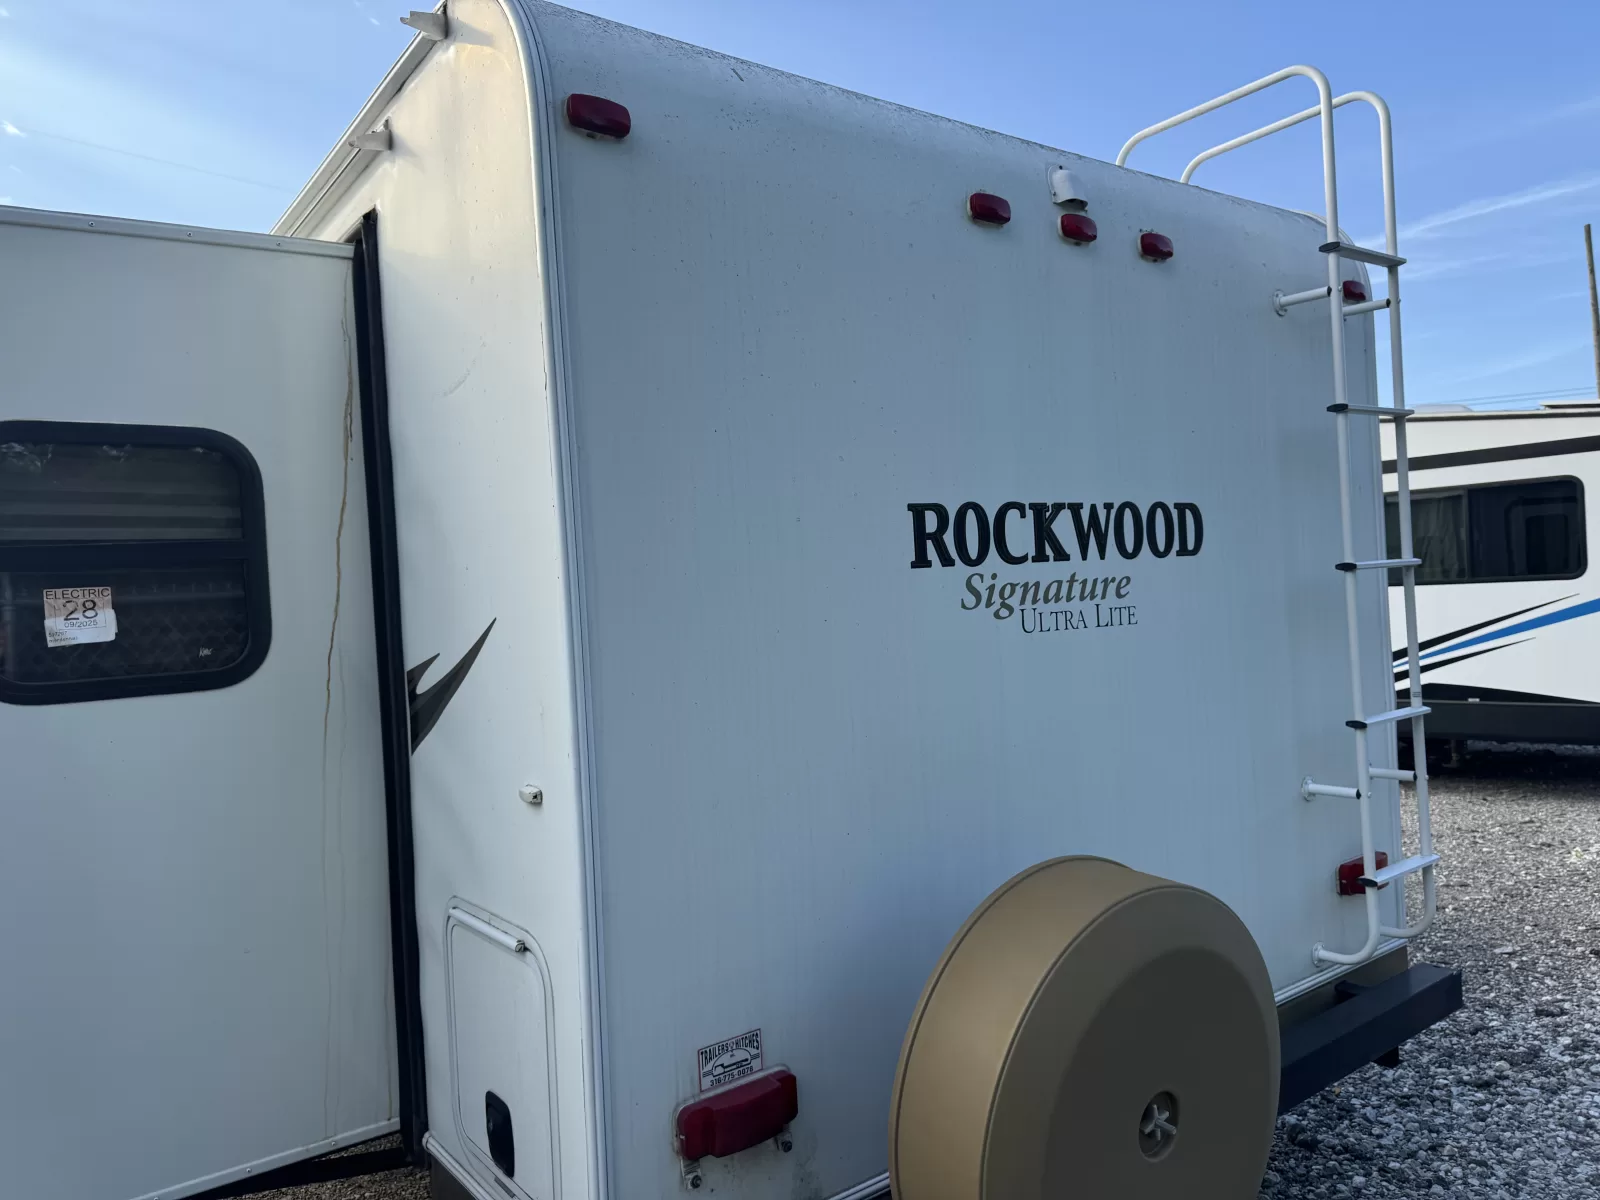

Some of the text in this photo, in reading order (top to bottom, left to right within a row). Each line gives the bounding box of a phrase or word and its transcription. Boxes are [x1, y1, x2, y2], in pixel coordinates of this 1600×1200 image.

[907, 501, 1204, 569] ROCKWOOD
[46, 588, 110, 600] ELECTRIC
[960, 572, 1131, 620] Signature
[63, 599, 98, 621] 28
[65, 620, 98, 628] 09/2025
[701, 1033, 759, 1070] TRAILERS HITCHES
